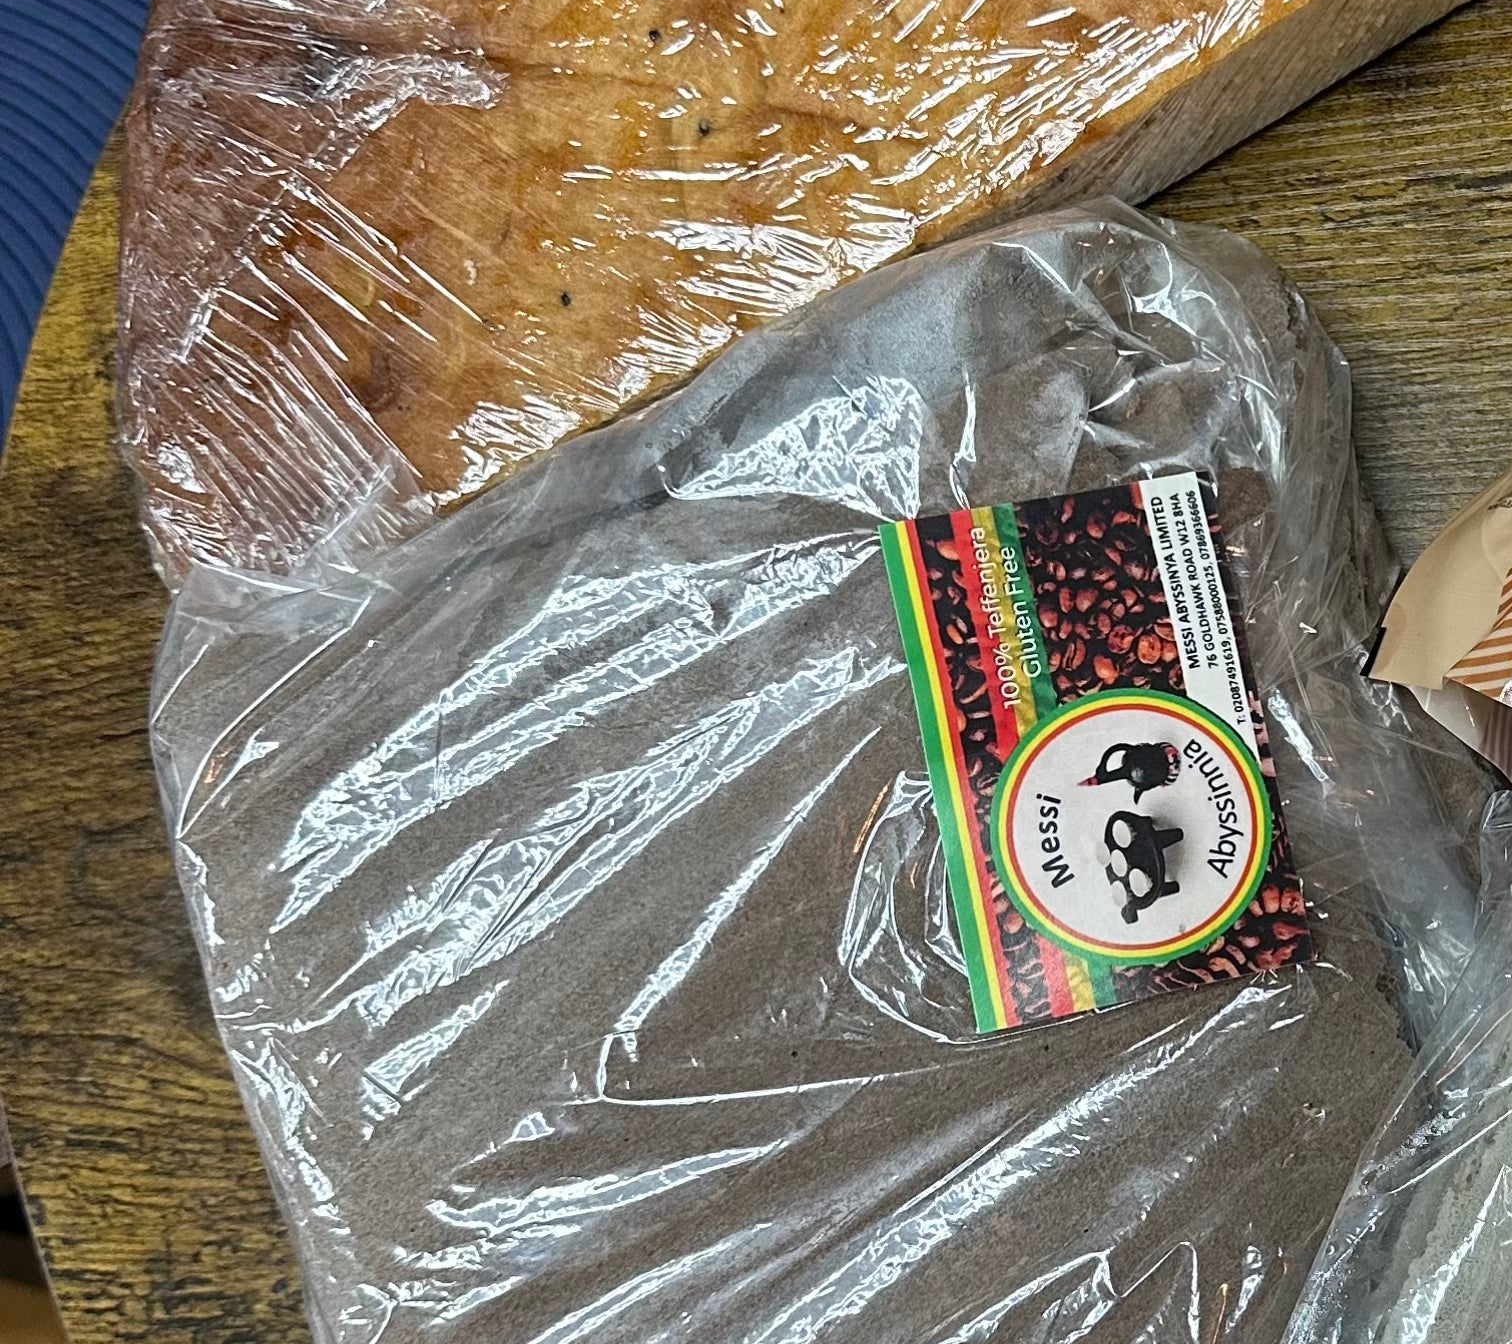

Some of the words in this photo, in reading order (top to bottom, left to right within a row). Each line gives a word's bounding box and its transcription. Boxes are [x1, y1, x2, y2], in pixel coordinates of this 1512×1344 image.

[1151, 496, 1173, 550] LIMITED
[1169, 492, 1183, 517] 8HA
[1175, 518, 1189, 543] W12
[970, 527, 1007, 640] Teffenjera
[1001, 546, 1024, 596] Free
[1164, 552, 1190, 625] ABYSSINYA
[1183, 549, 1200, 581] ROAD
[1012, 600, 1042, 678] Gluten
[1193, 582, 1216, 652] GOLDHAWK
[992, 642, 1021, 710] 100%
[1181, 627, 1201, 669] MESSI
[1208, 654, 1219, 669] 76
[1183, 737, 1244, 879] Abyssinnia
[1036, 792, 1076, 889] Messi
